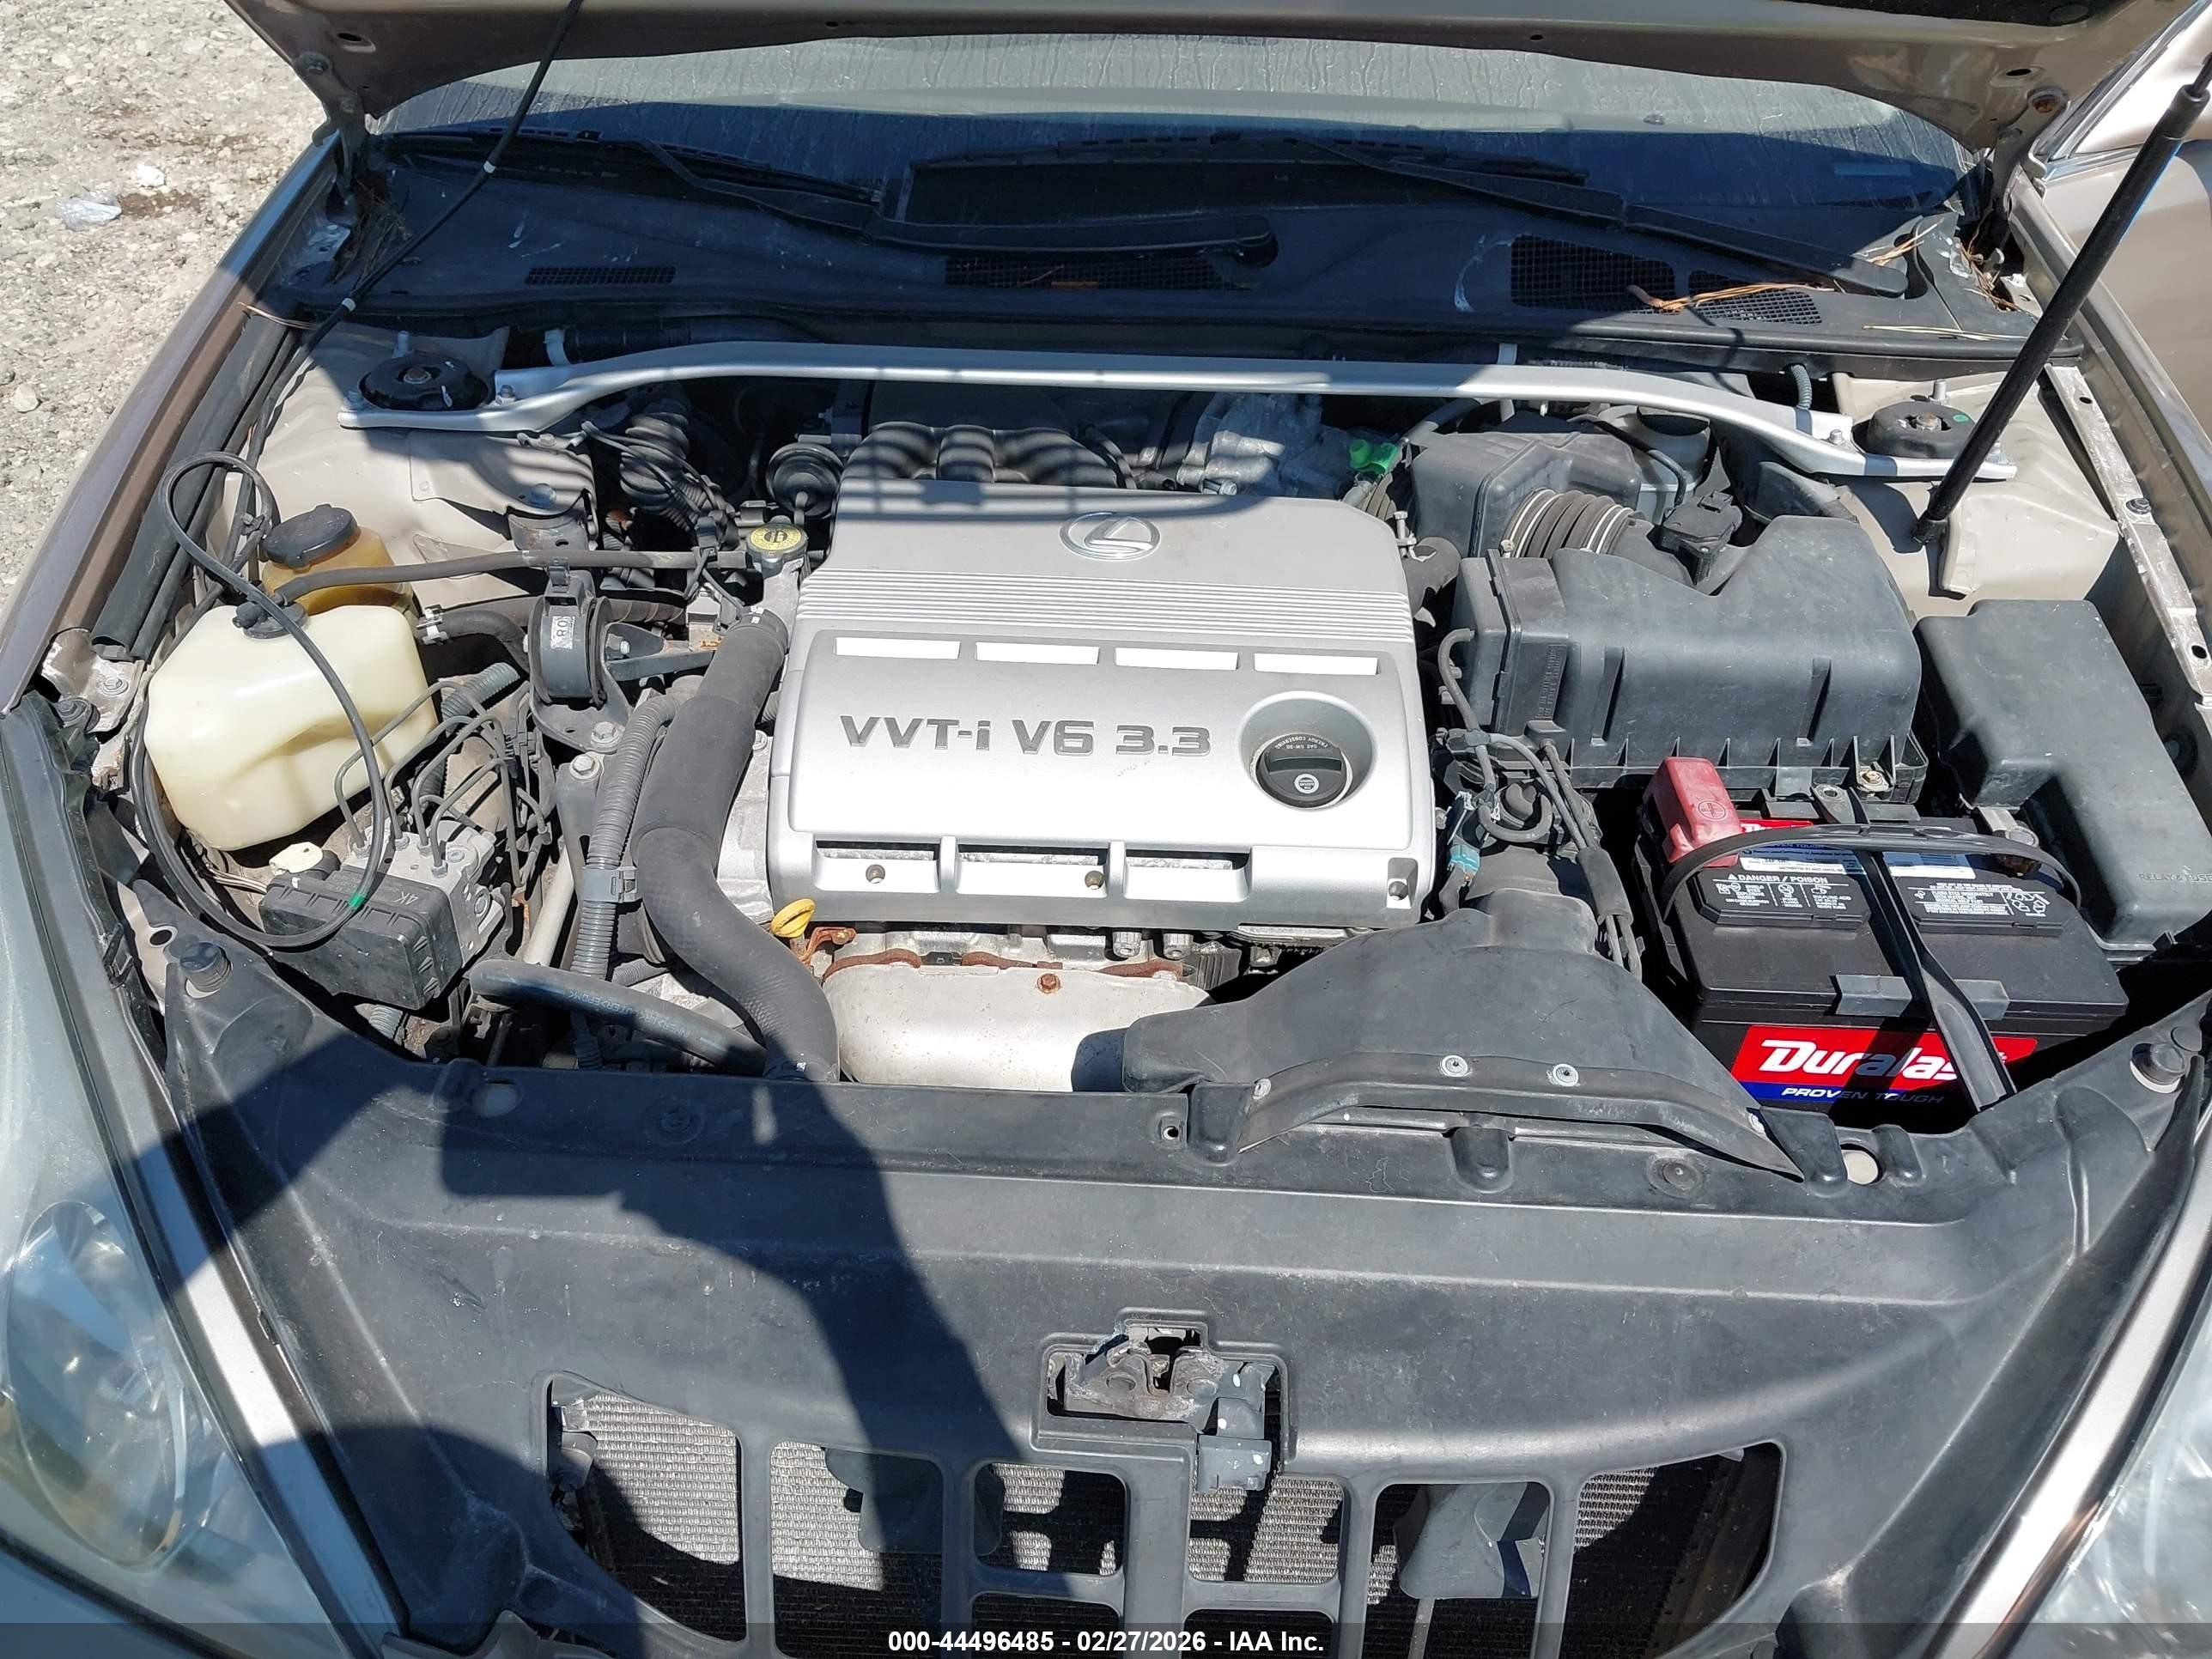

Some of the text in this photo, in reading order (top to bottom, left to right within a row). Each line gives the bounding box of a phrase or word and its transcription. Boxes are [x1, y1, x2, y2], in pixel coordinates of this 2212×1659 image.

[839, 714, 1212, 757] VVT-i V6 3.3
[1737, 874, 1781, 883] DANGER
[1759, 1039, 1958, 1081] Duralas
[1781, 1086, 1945, 1104] PROVEN TOUGH
